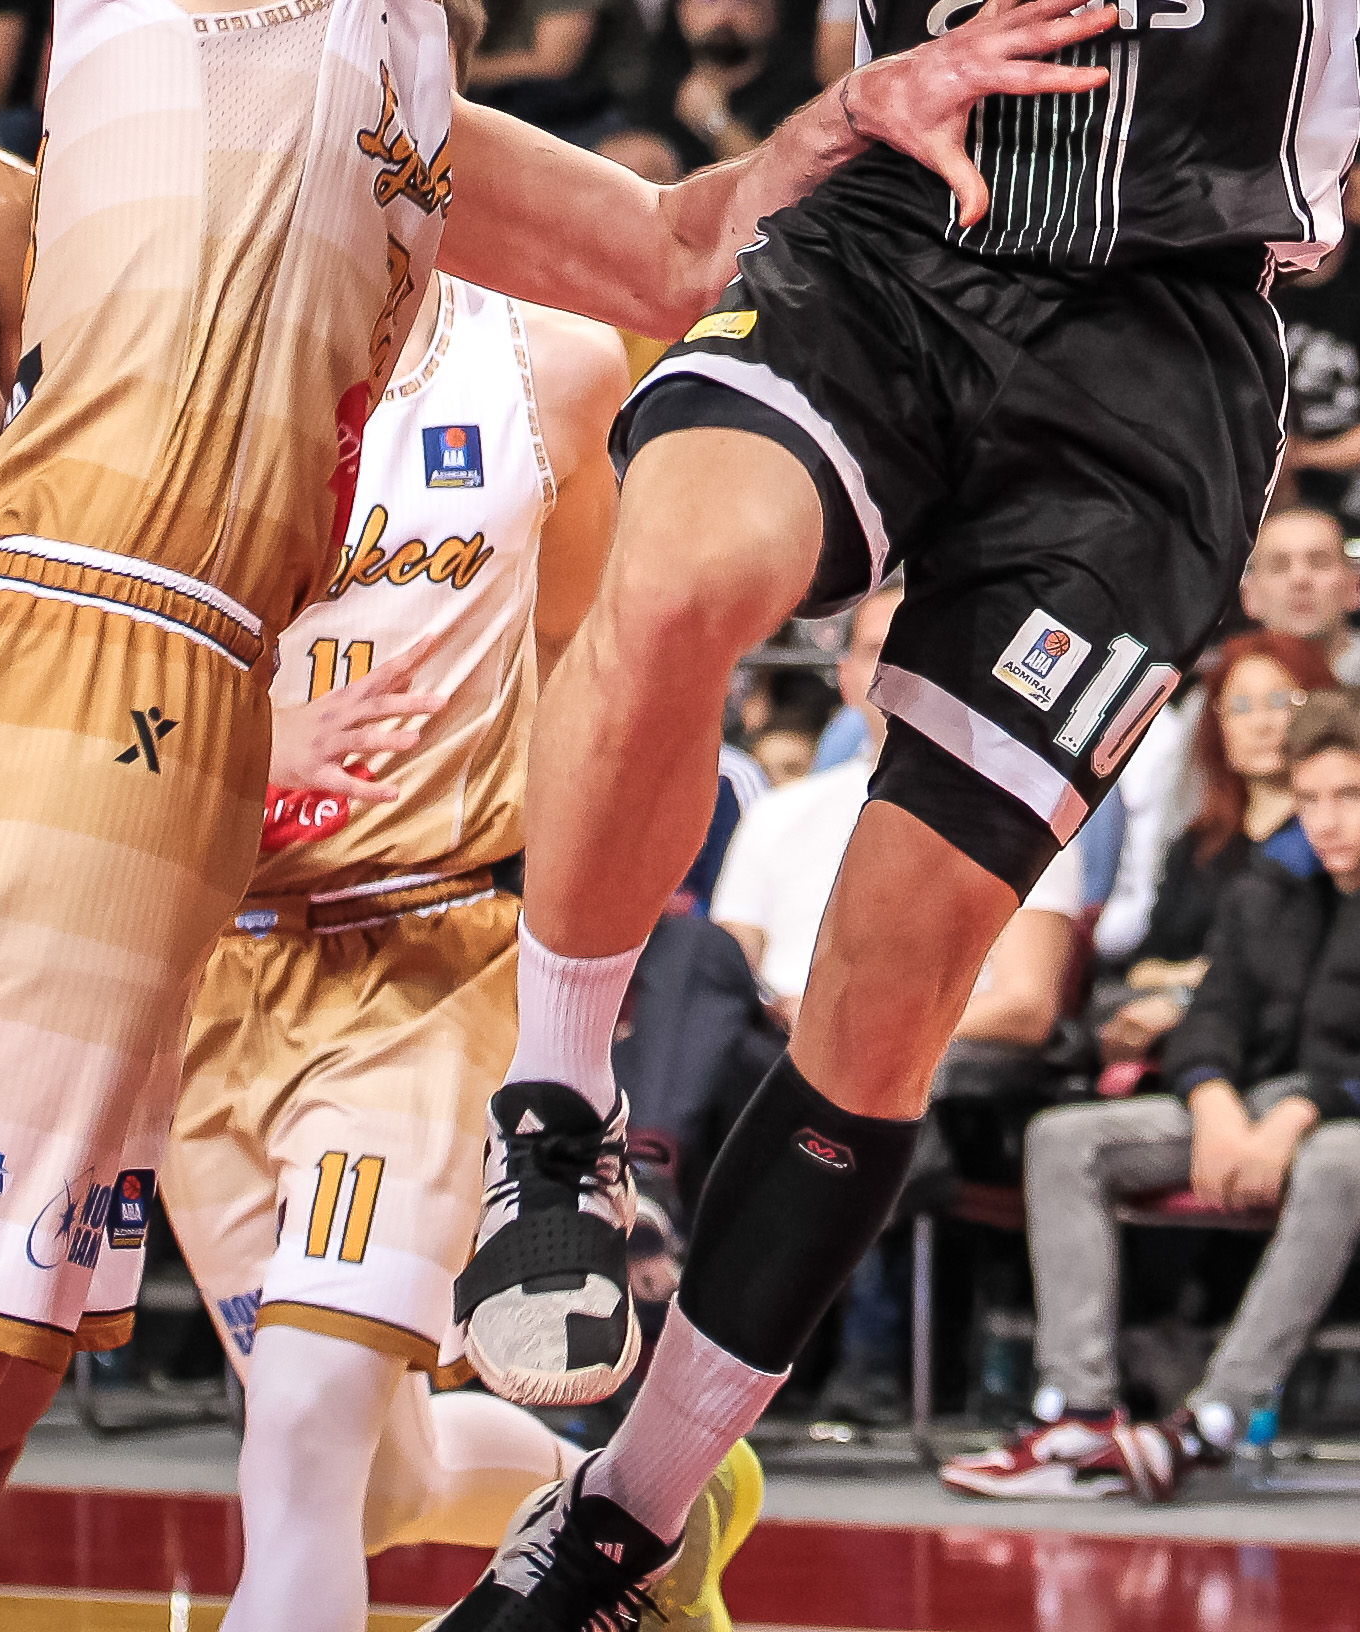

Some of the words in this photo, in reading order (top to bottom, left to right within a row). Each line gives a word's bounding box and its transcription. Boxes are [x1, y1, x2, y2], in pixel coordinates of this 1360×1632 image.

[1003, 661, 1051, 701] ADMIRAL
[1024, 648, 1054, 676] ABA
[1053, 632, 1182, 779] 10
[304, 1150, 386, 1265] 11
